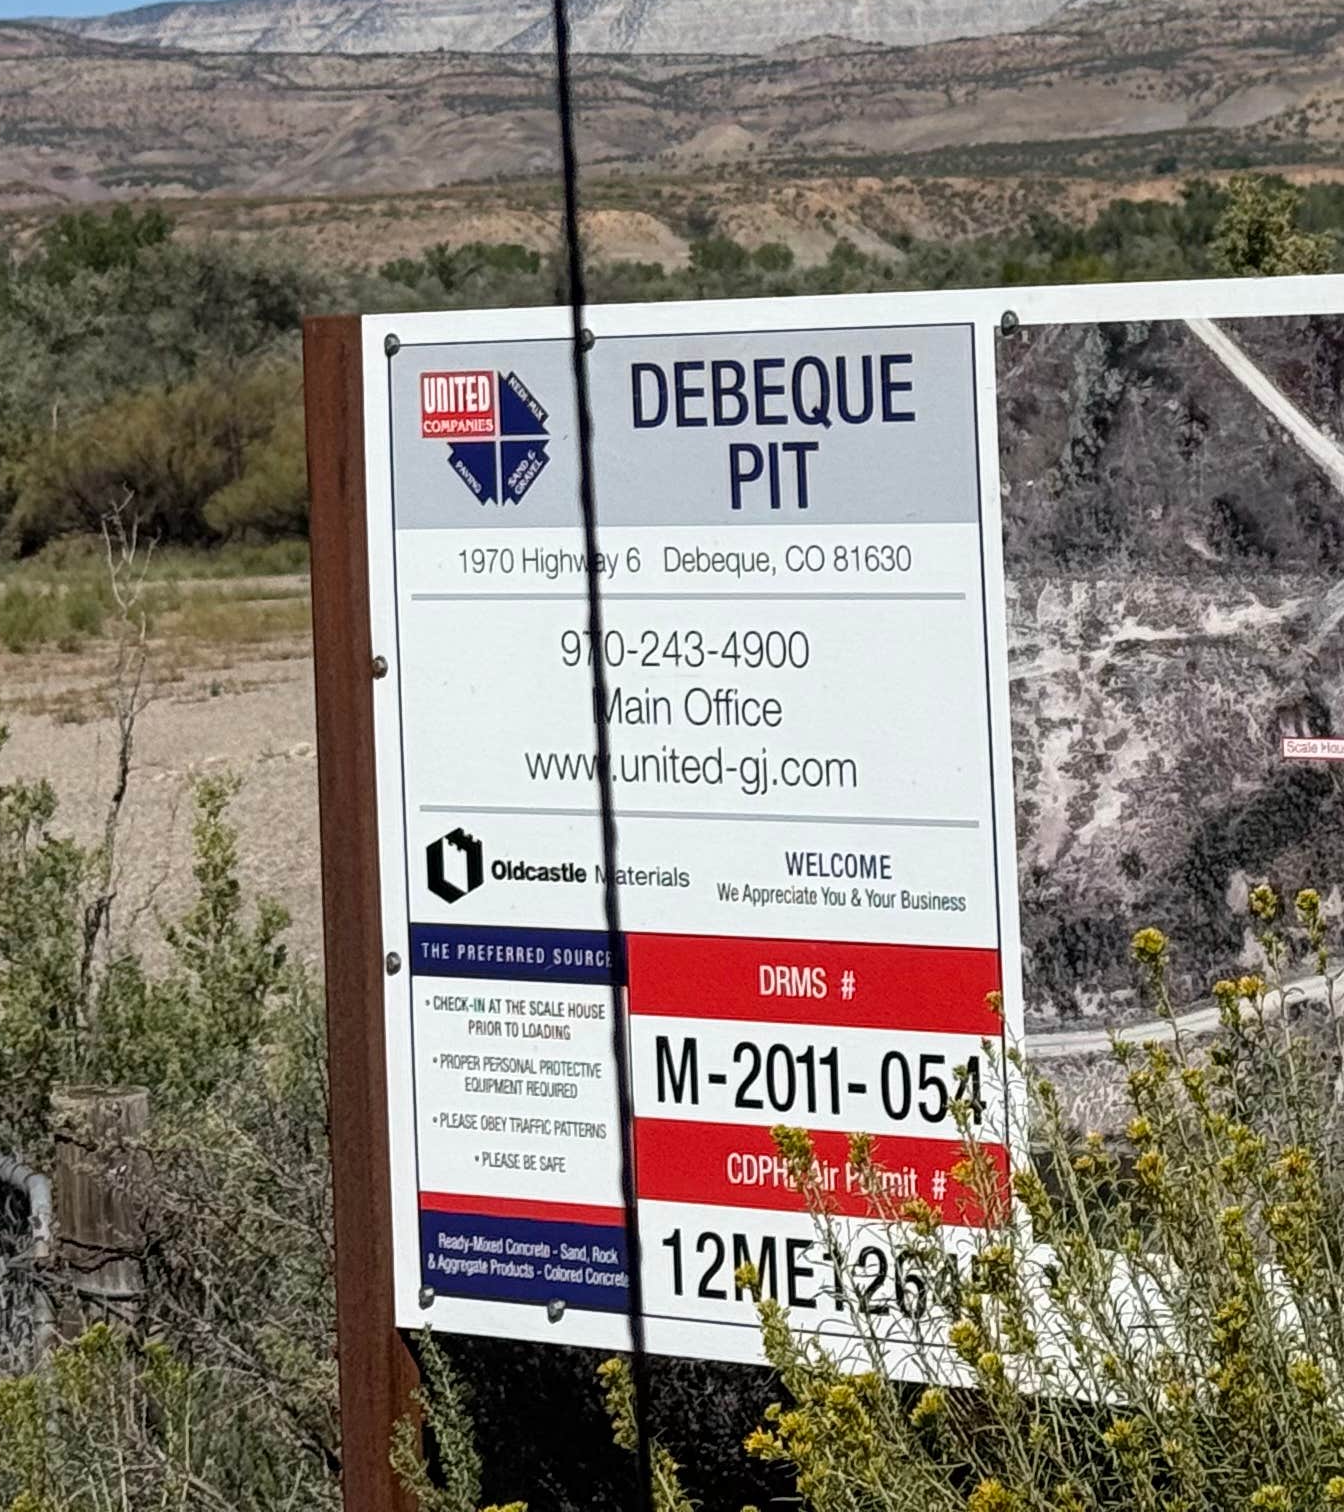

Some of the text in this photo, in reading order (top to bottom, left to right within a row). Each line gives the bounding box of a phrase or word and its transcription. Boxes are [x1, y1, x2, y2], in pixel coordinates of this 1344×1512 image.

[422, 375, 491, 414] UNITED
[631, 354, 916, 428] DEBEQUE
[422, 418, 494, 433] COMPANIES
[455, 460, 482, 494] PAVING
[508, 459, 530, 488] SAND
[514, 459, 543, 495] GRAVEL
[728, 442, 820, 510] PIT
[458, 545, 912, 579] 1970 Highway 6 Debeque, CO 81630
[684, 687, 782, 727] Office
[1286, 740, 1318, 754] Scale
[491, 860, 690, 888] Oldcastle Materials
[785, 851, 892, 879] WELCOME
[717, 882, 966, 912] We Appreciate You & Your Business
[421, 942, 613, 968] THE PREFERRED SOURCE
[759, 964, 856, 1001] DRMS #
[433, 995, 605, 1020] CHECK-IN AT THE SCALE HOUSE
[468, 1019, 571, 1041] PRIOR TO LOADING
[440, 1054, 602, 1079] PROPER PERSONAL PROTECTIVE
[464, 1076, 578, 1099] EQUIPMENT REQUIRED
[439, 1112, 607, 1139] PLEASE OBEY TRAFFIC PATTERNS
[481, 1151, 566, 1173] PLEASE BE SAFE
[931, 1169, 947, 1201] #
[438, 1232, 503, 1254] Ready-Mixed
[505, 1238, 550, 1258] Concrete
[560, 1244, 590, 1264] Sand,
[592, 1246, 619, 1265] Rock
[427, 1252, 436, 1269] &
[438, 1254, 488, 1276] Aggregate
[490, 1259, 534, 1279] Products
[543, 1264, 583, 1283] Colored
